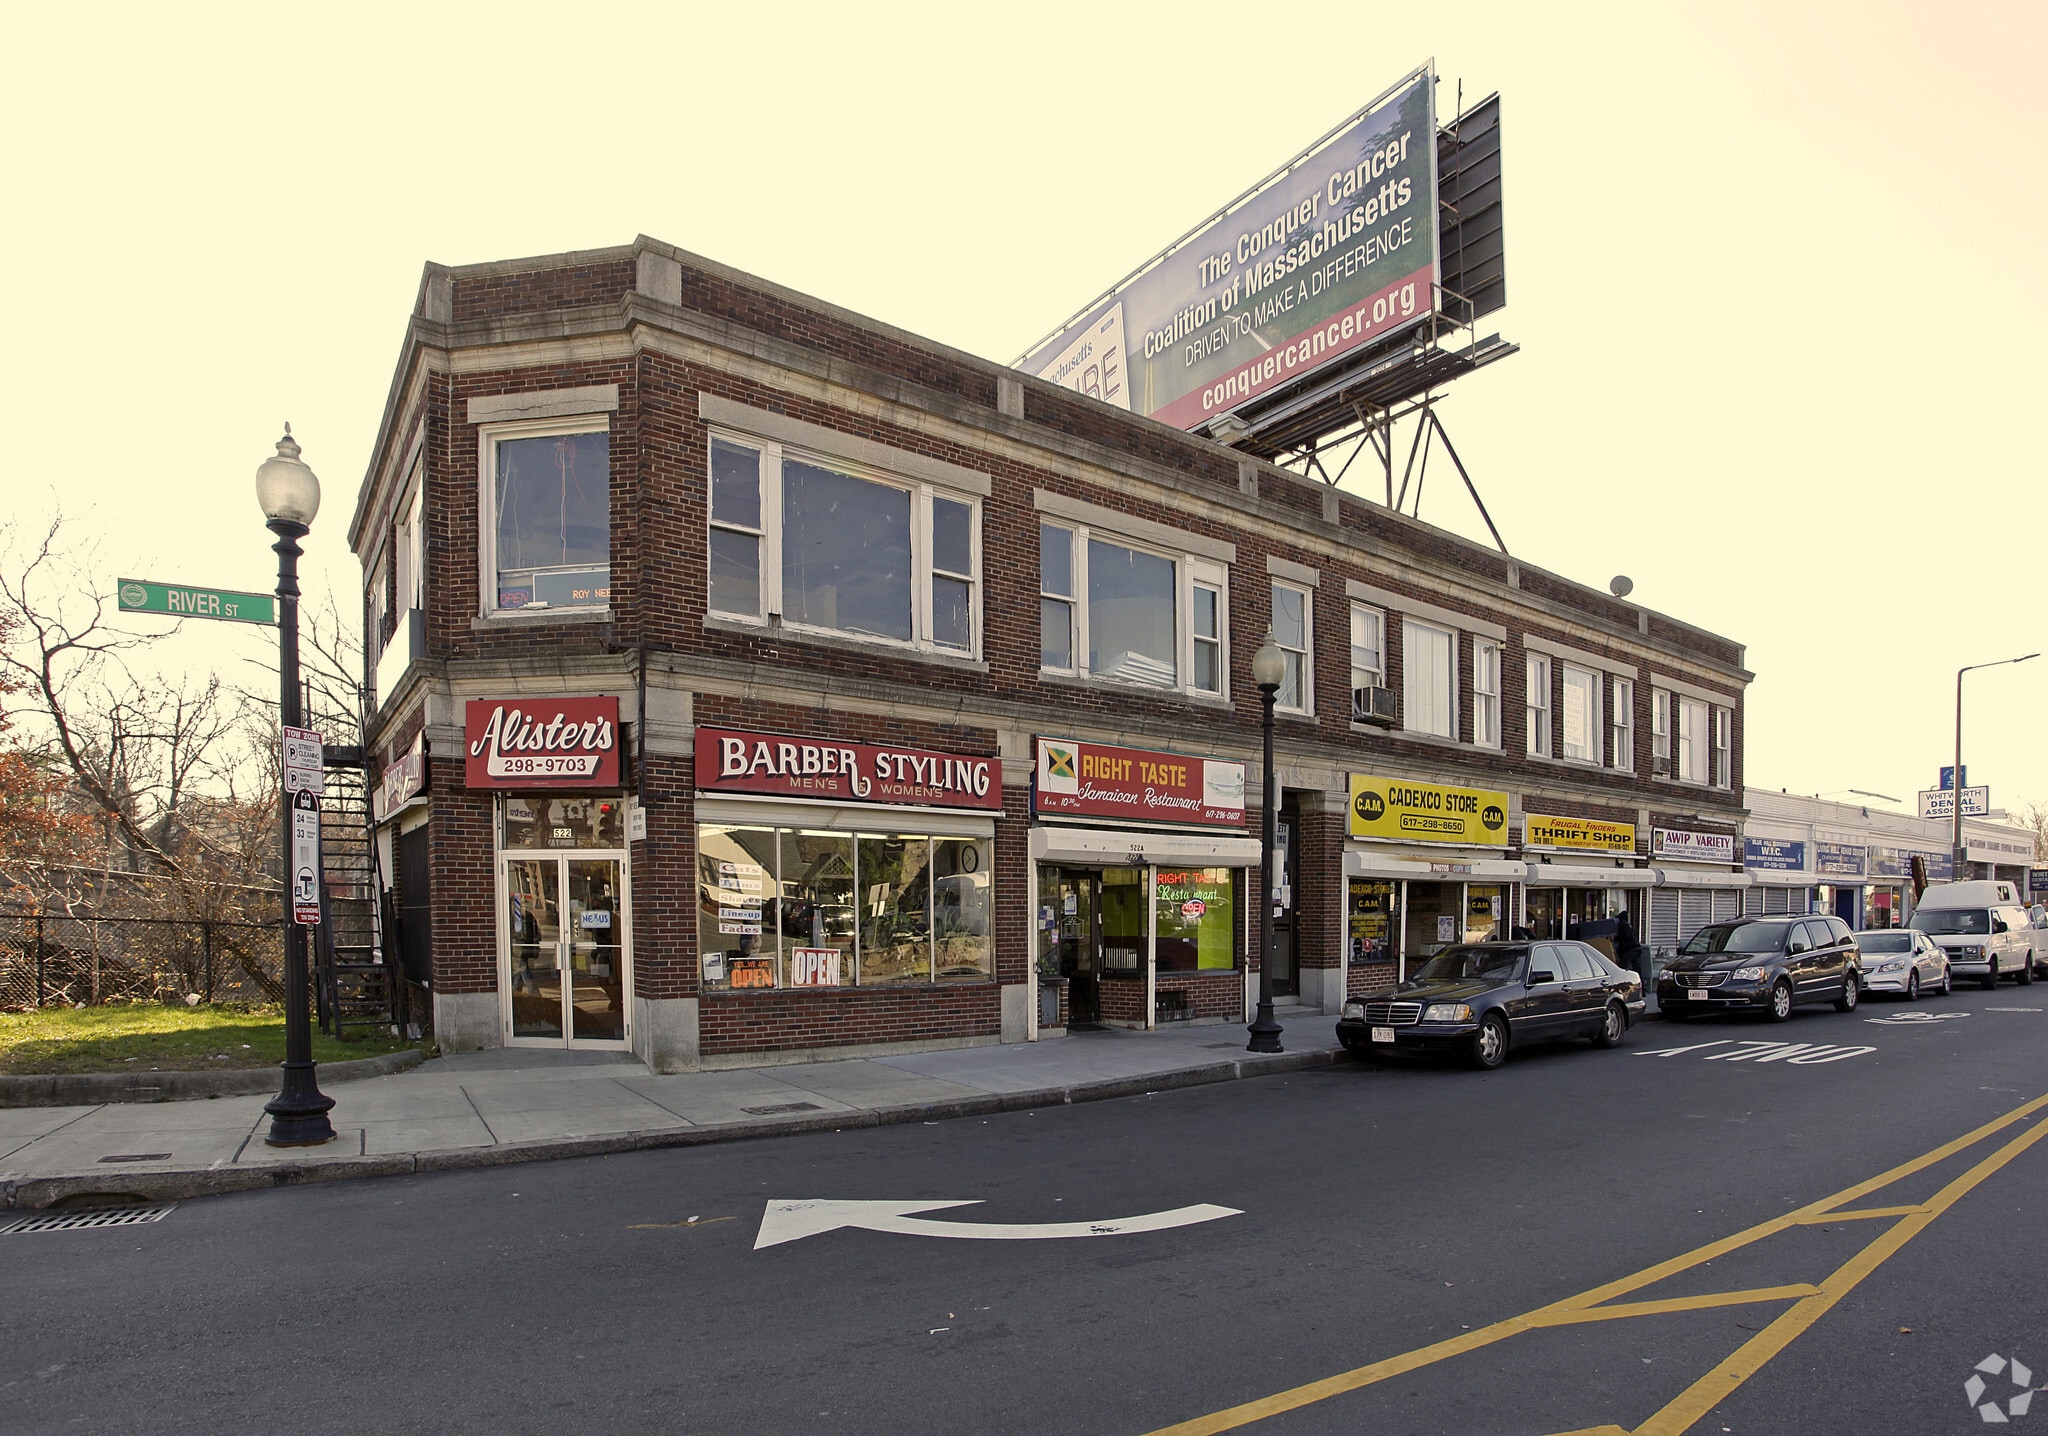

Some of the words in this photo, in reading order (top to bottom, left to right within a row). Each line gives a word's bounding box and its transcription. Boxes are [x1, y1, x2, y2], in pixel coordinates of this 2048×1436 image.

[1199, 251, 1231, 288] The
[1236, 191, 1322, 265] Conquer
[1327, 131, 1411, 206] Cancer
[1145, 297, 1216, 359] Coalition
[1221, 275, 1240, 312] of
[1245, 177, 1412, 299] Massachusetts
[1185, 323, 1230, 367] DRIVEN
[1233, 312, 1251, 339] TO
[1254, 286, 1293, 329] MAKE
[1298, 280, 1308, 304] A
[1312, 217, 1412, 296] DIFFERENCE
[1202, 282, 1416, 410] conquercancer.org
[1049, 341, 1093, 384] achusetts
[500, 592, 529, 604] OPEN
[572, 589, 591, 599] ROY
[168, 590, 220, 615] RIVER
[225, 604, 239, 616] ST
[287, 730, 301, 738] TOW
[303, 733, 320, 742] ZONE
[470, 706, 613, 757] Alister's
[299, 751, 320, 759] CLEANING
[504, 759, 587, 772] 298-9703
[720, 737, 871, 797] BARBER
[876, 752, 990, 796] STYLING
[1083, 755, 1132, 781] RIGHT
[1139, 761, 1186, 787] TASTE
[790, 777, 838, 790] MEN'S
[859, 782, 867, 793] &
[880, 783, 943, 798] WOMEN'S
[1044, 797, 1049, 805] 6
[1078, 782, 1139, 805] Jamaican
[1144, 787, 1202, 812] Restaurant
[1388, 787, 1441, 810] CADEXCO
[1446, 794, 1478, 813] STORE
[1926, 790, 1981, 800] WHITWRTH
[1357, 798, 1382, 812] C.A.M.
[1931, 798, 1975, 807] DENAL
[1925, 805, 1981, 815] ASSOCATES
[296, 814, 304, 823] 24
[1403, 818, 1462, 830] 617-298-8650
[1550, 819, 1581, 829] FRUGAL
[1585, 822, 1616, 832] FINDERS
[296, 829, 304, 838] 33
[1531, 827, 1589, 840] THRIFT
[1593, 833, 1631, 843] SHOP
[1666, 832, 1690, 844] AWIP
[1696, 835, 1730, 848] VARIETY
[1761, 846, 1782, 856] W.I.C.
[722, 864, 759, 873] Cuts
[1432, 864, 1450, 872] PHOTOS
[1453, 864, 1464, 872] COPY
[1157, 873, 1188, 884] RIGHT
[300, 876, 312, 895] T
[1350, 884, 1372, 893] ADEXCO
[721, 895, 760, 903] Shaves
[721, 909, 760, 919] Line-up
[1182, 903, 1205, 914] OPEN
[582, 913, 608, 923] NEXUS
[721, 924, 759, 933] Fades
[794, 952, 838, 985] OPEN
[731, 969, 773, 988] OPEN
[1632, 1039, 1877, 1064] ONLY
